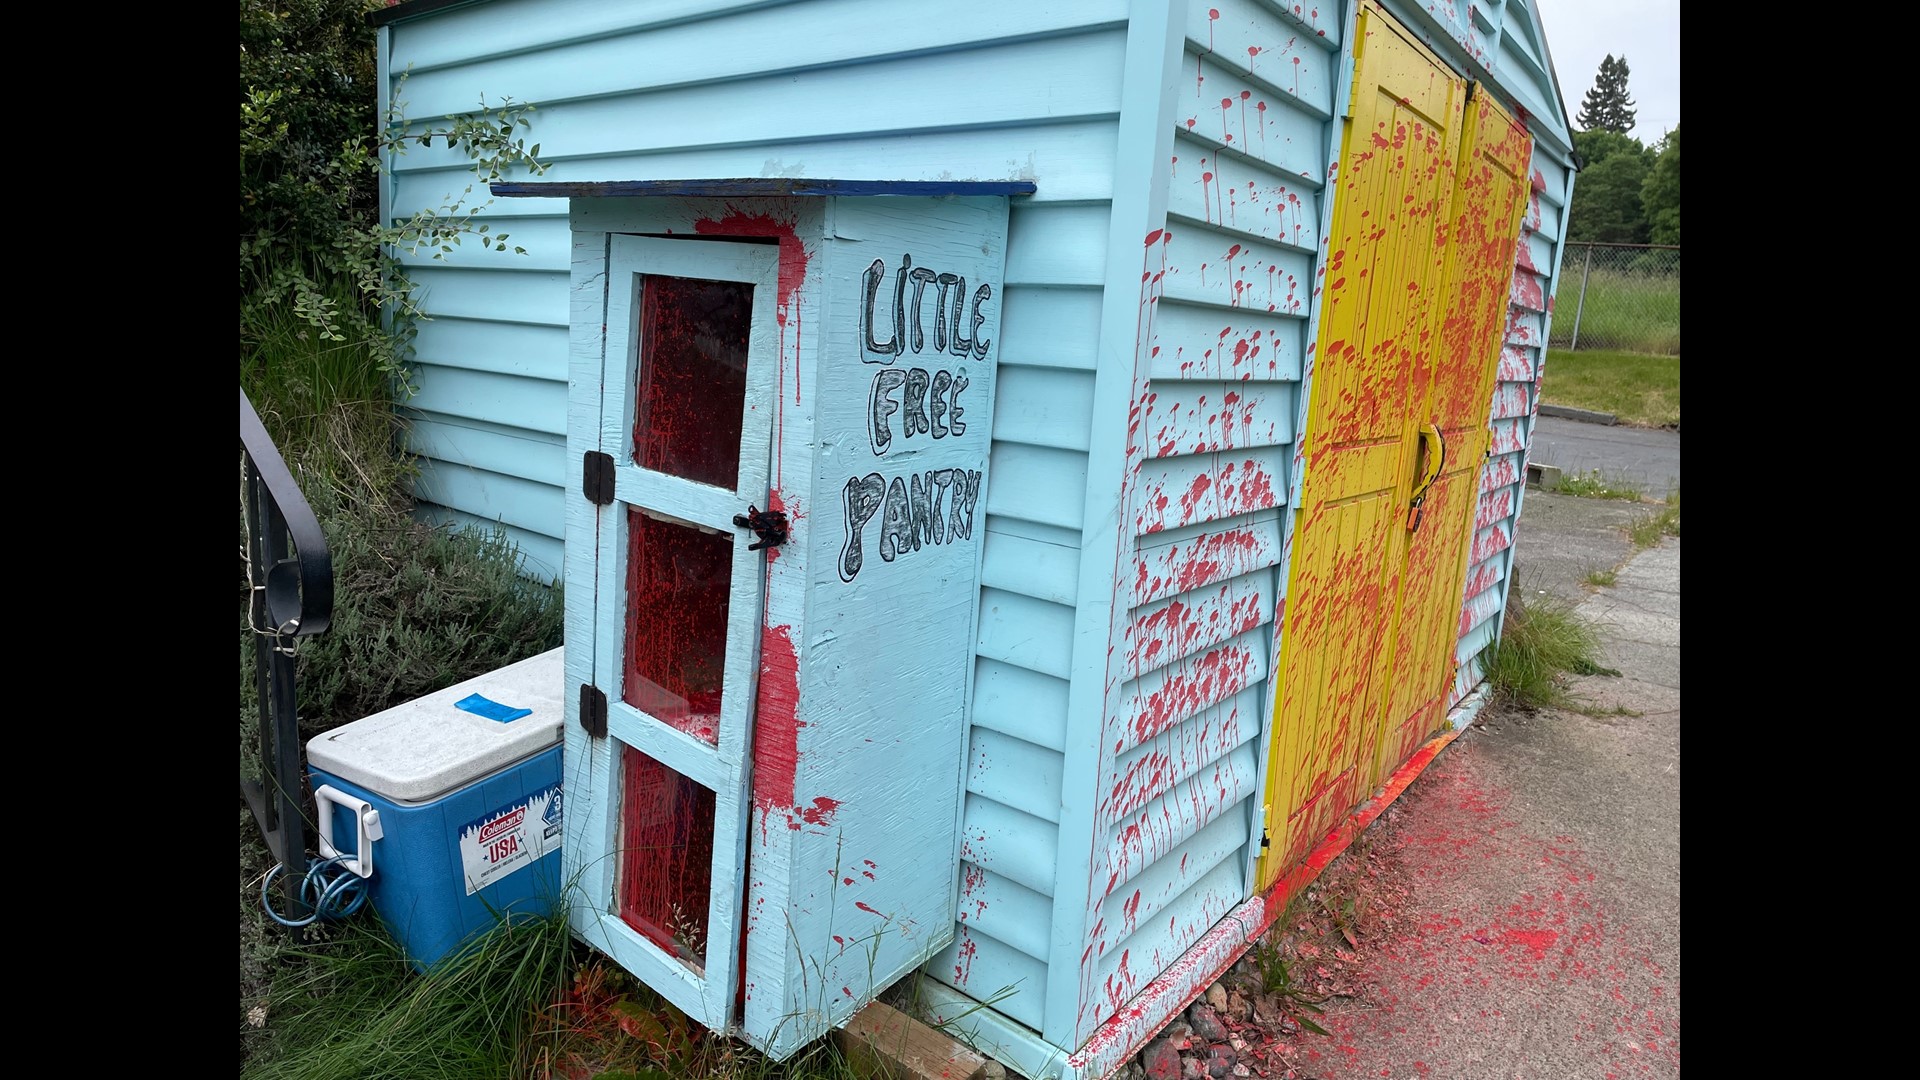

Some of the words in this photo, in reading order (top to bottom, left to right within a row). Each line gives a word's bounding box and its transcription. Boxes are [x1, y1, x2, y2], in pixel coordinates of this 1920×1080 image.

[867, 368, 969, 456] FREE
[838, 468, 982, 583] PANTRY
[482, 817, 516, 839] Coleman
[489, 834, 518, 864] USA
